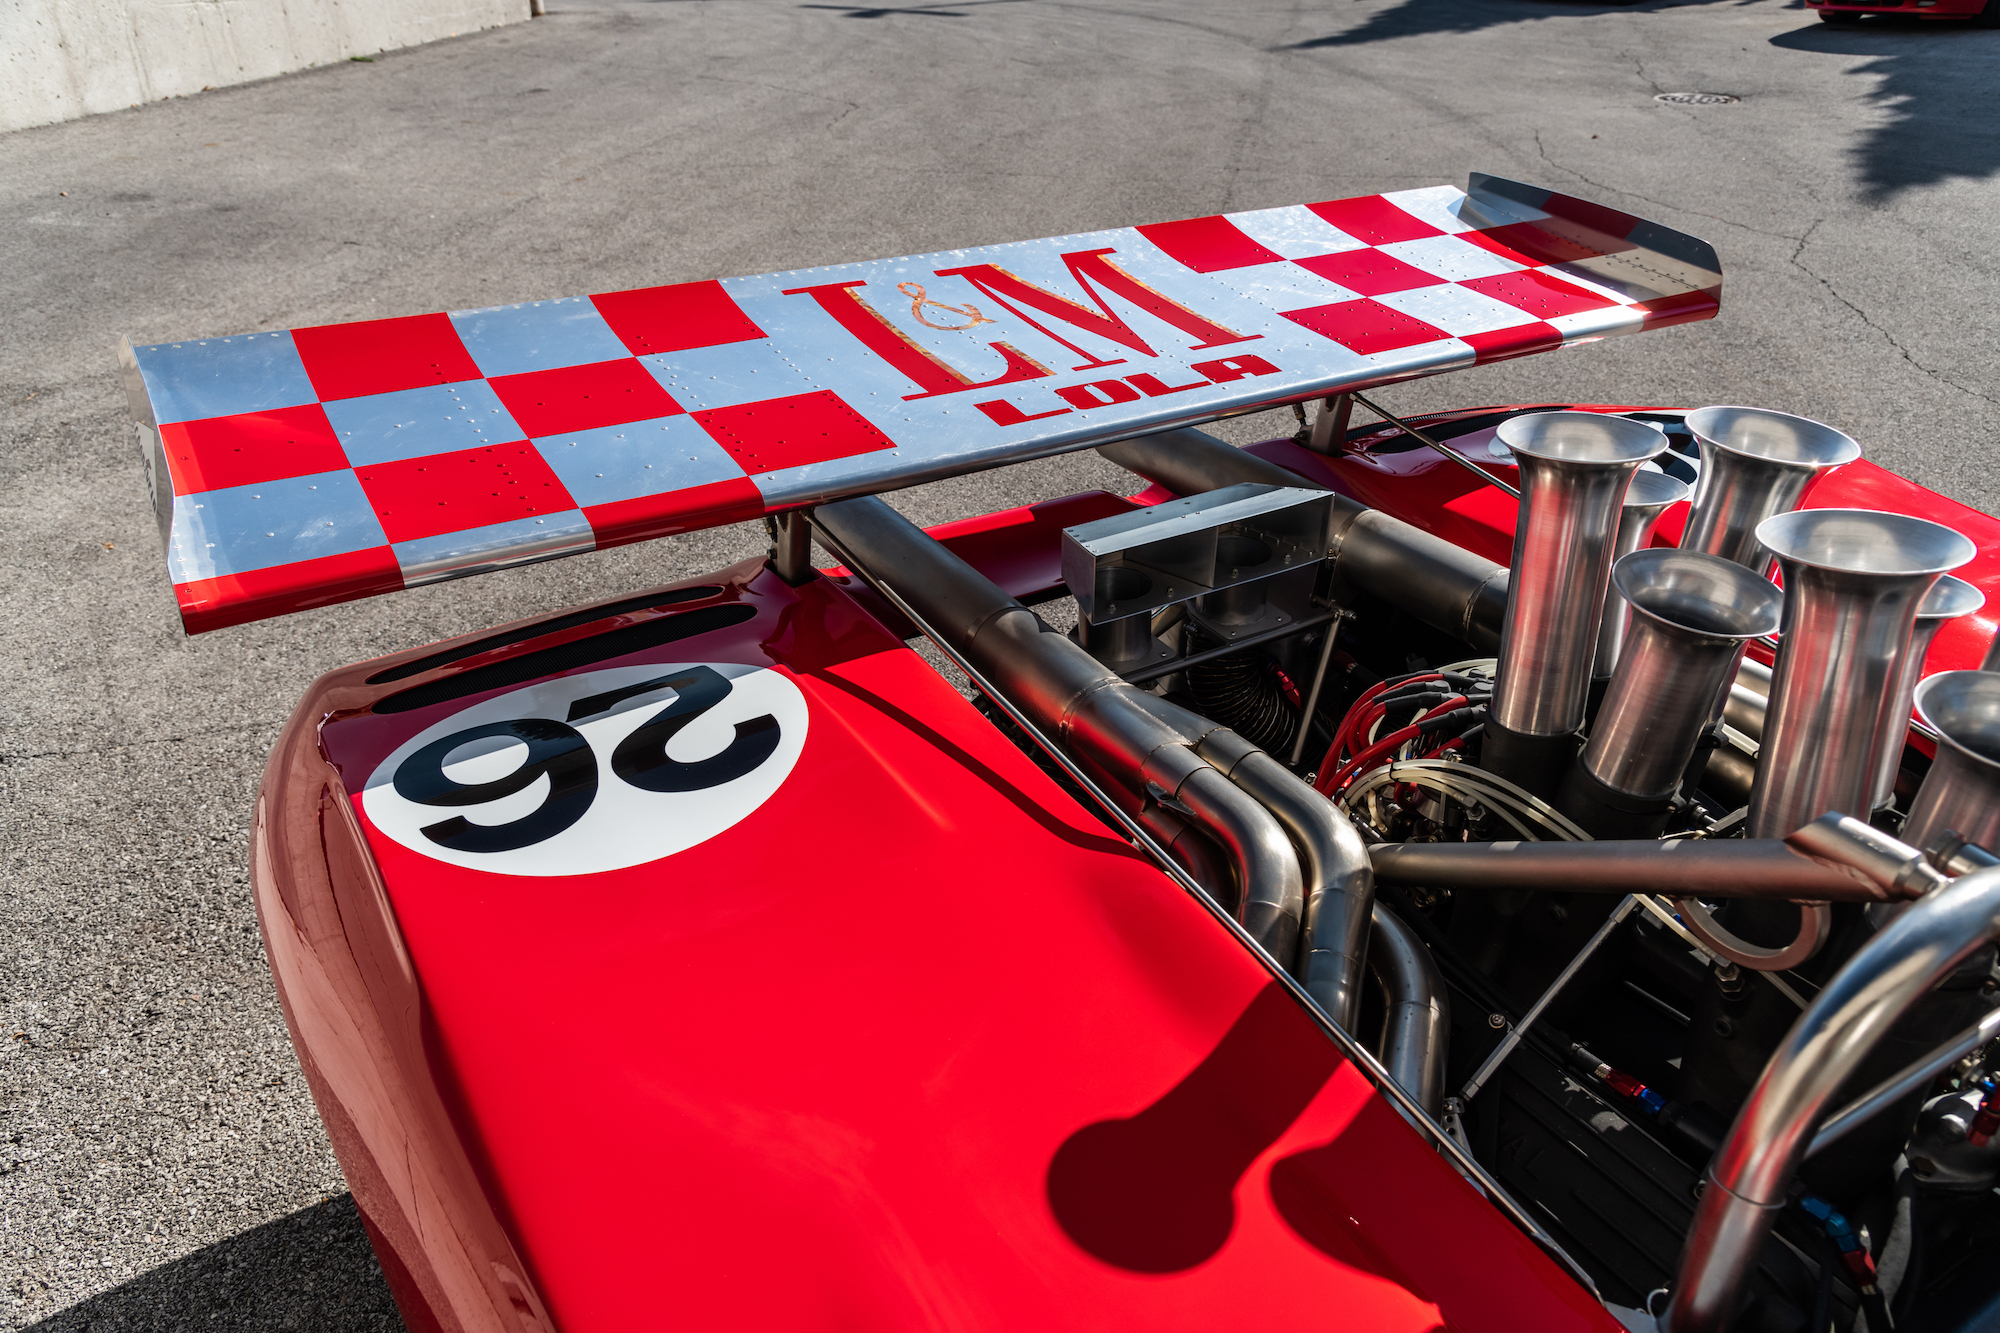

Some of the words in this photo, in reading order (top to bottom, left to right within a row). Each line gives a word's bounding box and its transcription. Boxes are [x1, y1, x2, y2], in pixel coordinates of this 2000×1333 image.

[781, 247, 1264, 401] L&M
[973, 354, 1282, 427] LOLA
[393, 665, 781, 853] 26
